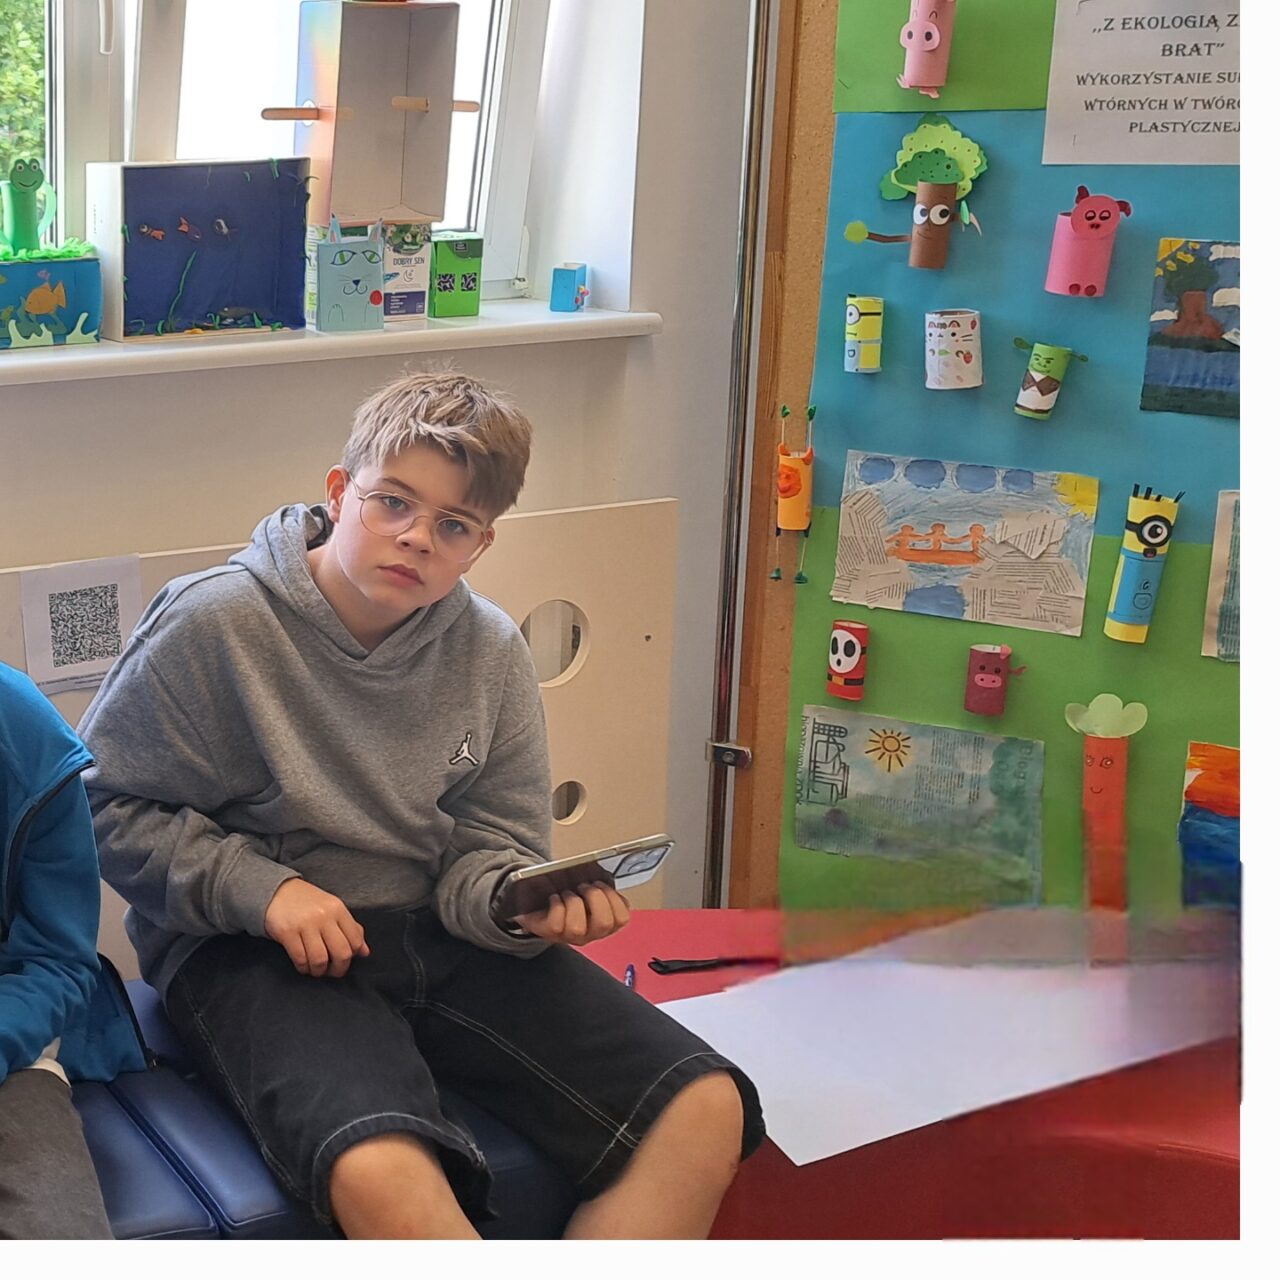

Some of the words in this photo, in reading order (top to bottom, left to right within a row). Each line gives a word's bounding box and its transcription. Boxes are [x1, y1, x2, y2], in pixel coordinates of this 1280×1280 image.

[1120, 14, 1221, 33] EKOLOGIĄ
[1076, 72, 1212, 86] WYKORZYSTANIE
[1084, 96, 1168, 111] WTÓRNYCH
[1173, 97, 1188, 110] W
[1128, 121, 1241, 133] PLASTYCZNEJ
[393, 257, 412, 266] DOBRY
[414, 257, 425, 265] SEN
